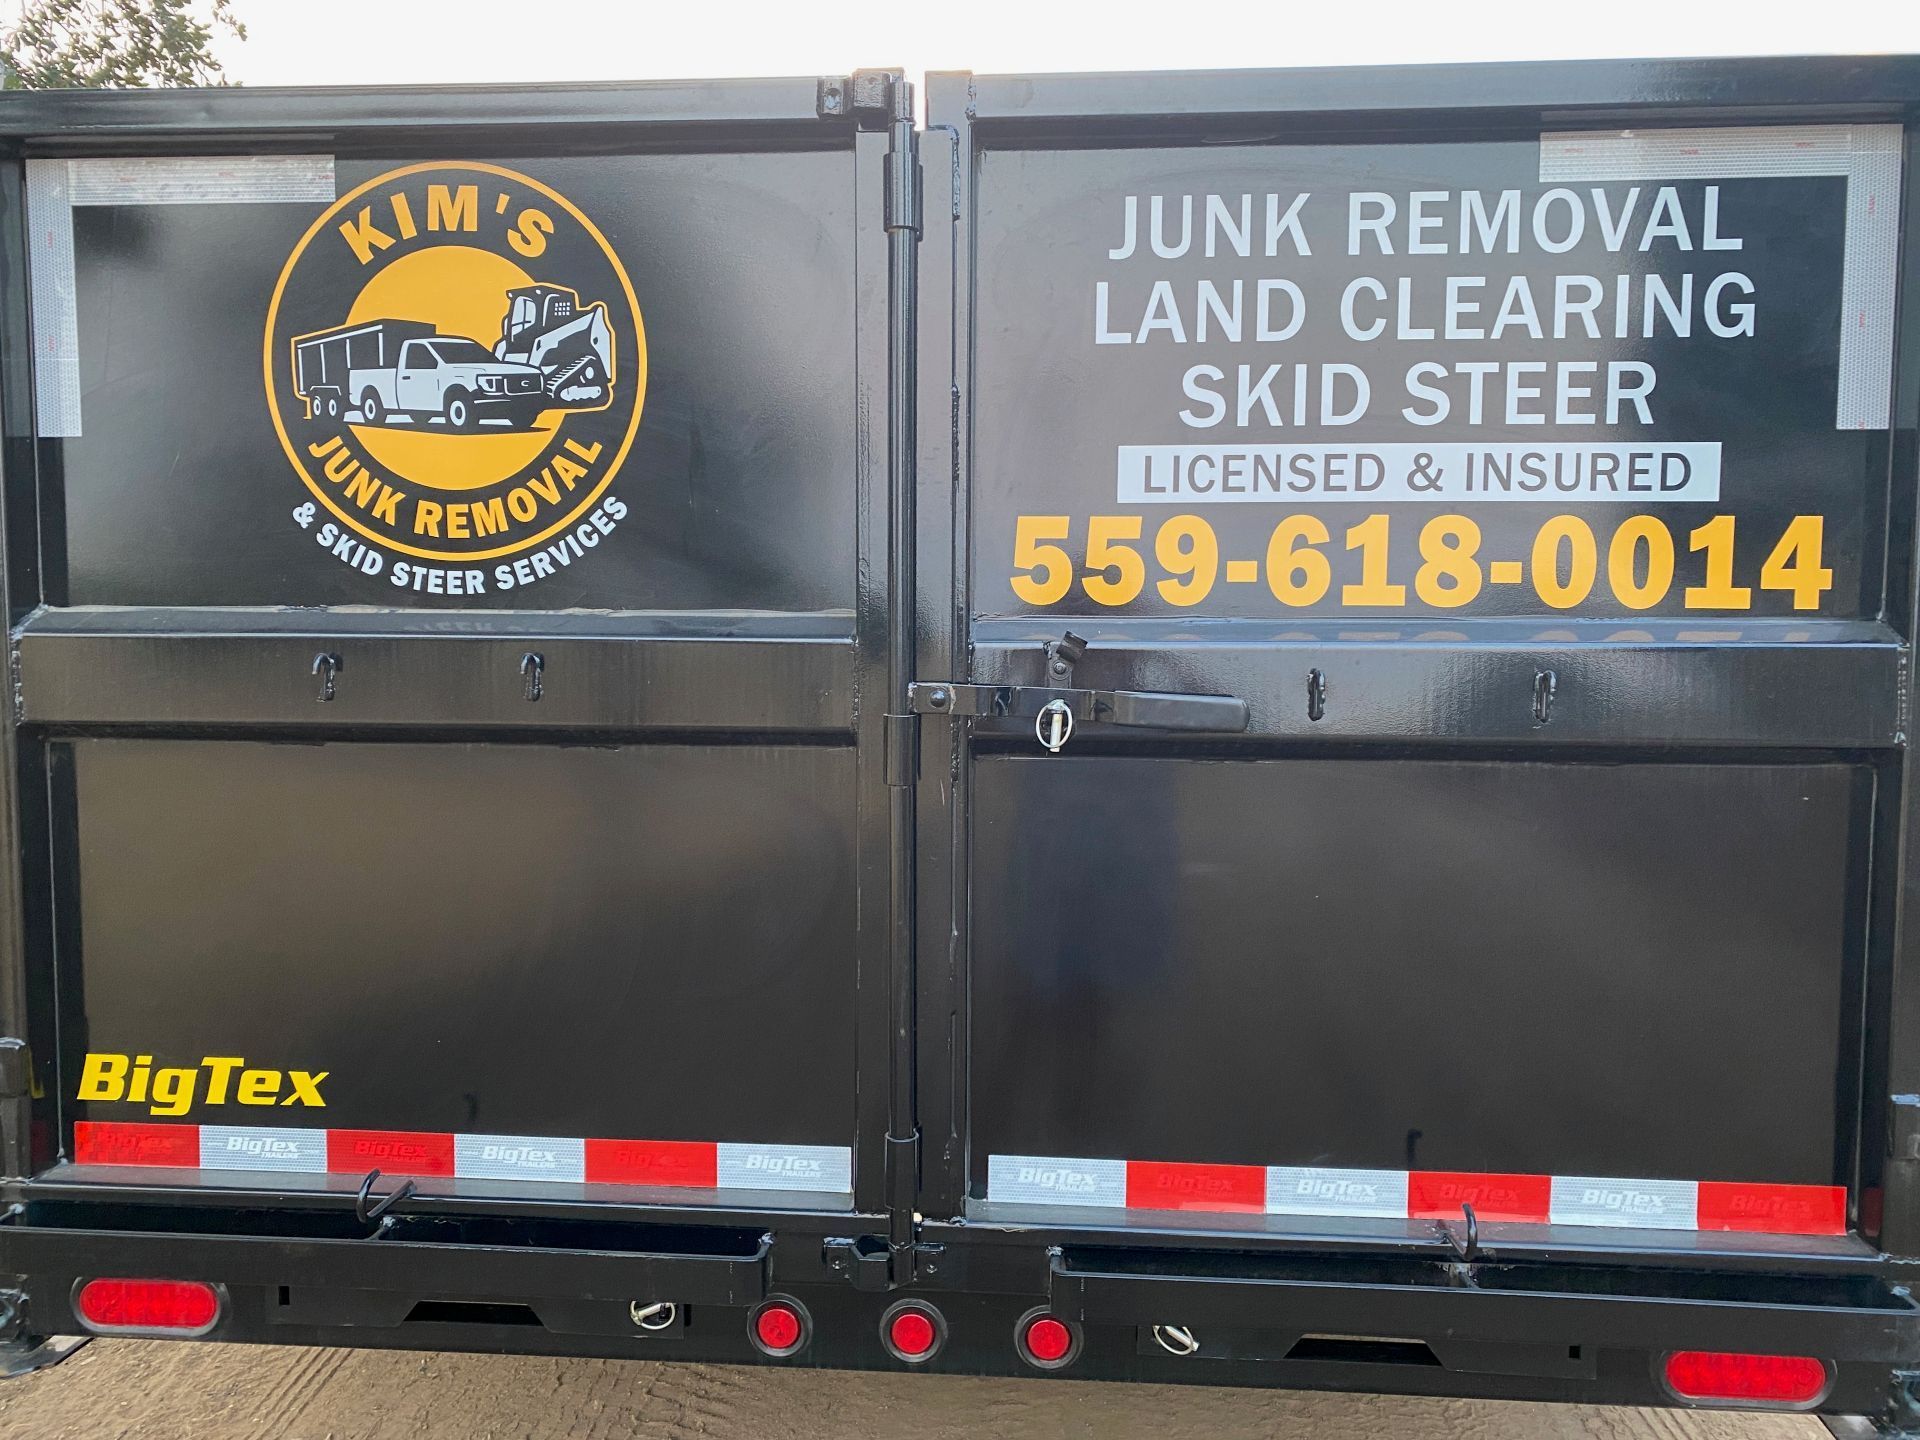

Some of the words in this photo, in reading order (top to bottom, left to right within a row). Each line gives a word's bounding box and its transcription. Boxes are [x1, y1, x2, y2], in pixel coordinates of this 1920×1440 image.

[339, 185, 555, 265] KIM'S
[1108, 193, 1313, 260] JUNK
[1347, 186, 1743, 256] REMOVAL
[1094, 279, 1307, 345] LAND
[1340, 272, 1757, 342] CLEARING
[1178, 363, 1371, 430] SKID
[1400, 361, 1657, 427] STEER
[308, 435, 406, 526] JUNK
[413, 438, 603, 539] REMOVAL
[1143, 454, 1386, 494] LICENSED
[1406, 453, 1444, 492] &
[1465, 452, 1692, 492] INSURED
[292, 501, 316, 529] &
[315, 523, 384, 577] SKID
[390, 561, 486, 595] STEER
[495, 496, 628, 590] SERVICES
[1009, 514, 1834, 610] 559-618-0014
[76, 1053, 330, 1116] BigTex
[225, 1136, 300, 1156] BigTex
[481, 1145, 557, 1165] BigTex
[745, 1154, 823, 1173] BigTex
[1016, 1167, 1097, 1188] BigTex
[1296, 1178, 1378, 1199] BigTex
[1580, 1188, 1667, 1209] BigTex
